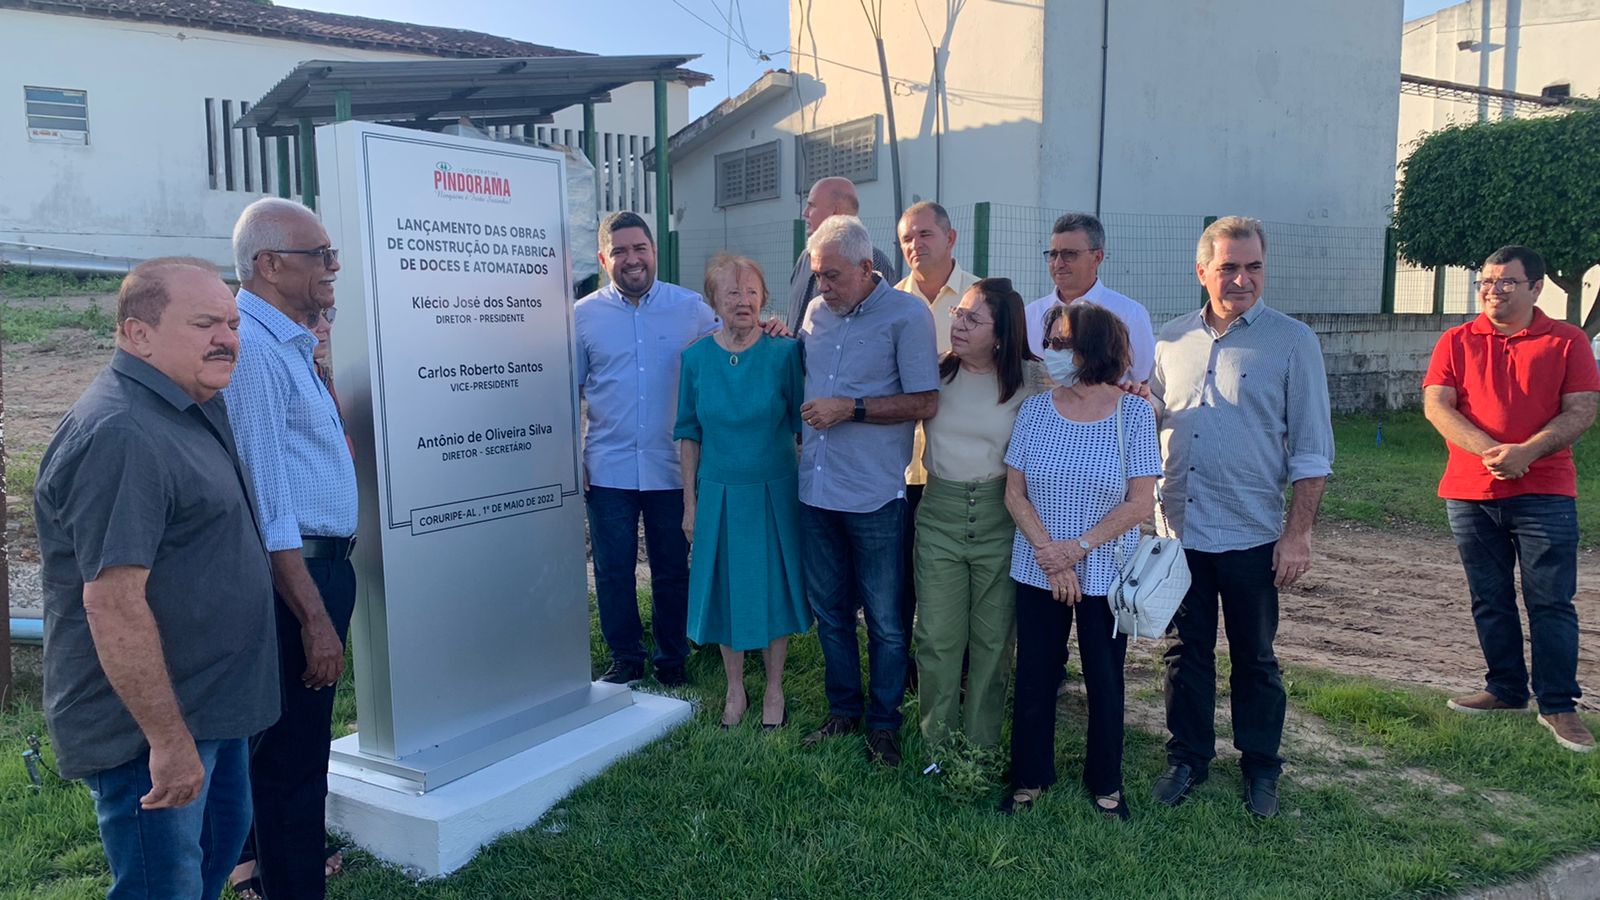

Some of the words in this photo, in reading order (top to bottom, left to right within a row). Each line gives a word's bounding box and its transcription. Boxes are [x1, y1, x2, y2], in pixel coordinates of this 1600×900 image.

[433, 170, 512, 198] PINDORAMA
[397, 218, 482, 236] LANÇAMENTO
[485, 224, 508, 237] DAS
[510, 226, 546, 240] OBRAS
[387, 237, 404, 250] DE
[407, 238, 490, 257] CONSTRUÇÃO
[493, 243, 509, 256] DA
[512, 244, 556, 258] FABRICA
[400, 258, 416, 270] DE
[420, 258, 460, 272] DOCES
[464, 260, 470, 272] E
[474, 261, 548, 275] ATOMATADOS
[412, 296, 450, 309] Klécio
[453, 296, 480, 309] José
[484, 296, 504, 308] dos
[506, 296, 542, 308] Santos
[436, 314, 472, 324] DIRETOR
[480, 314, 525, 323] PRESIDENTE
[418, 365, 456, 379] Carlos
[460, 364, 504, 377] Roberto
[508, 362, 543, 374] Santos
[450, 379, 519, 392] VICE-PRESIDENTE
[417, 434, 464, 450] Antônio
[468, 431, 482, 443] de
[485, 426, 526, 442] Oliveira
[529, 424, 552, 436] Silva
[442, 448, 478, 462] DIRETOR
[485, 442, 532, 456] SECRETÁRIO
[419, 508, 476, 527] CORURIPE-AL
[492, 504, 502, 512] DE
[504, 500, 524, 511] MAIO
[526, 498, 536, 507] DE
[538, 494, 554, 504] 2022
